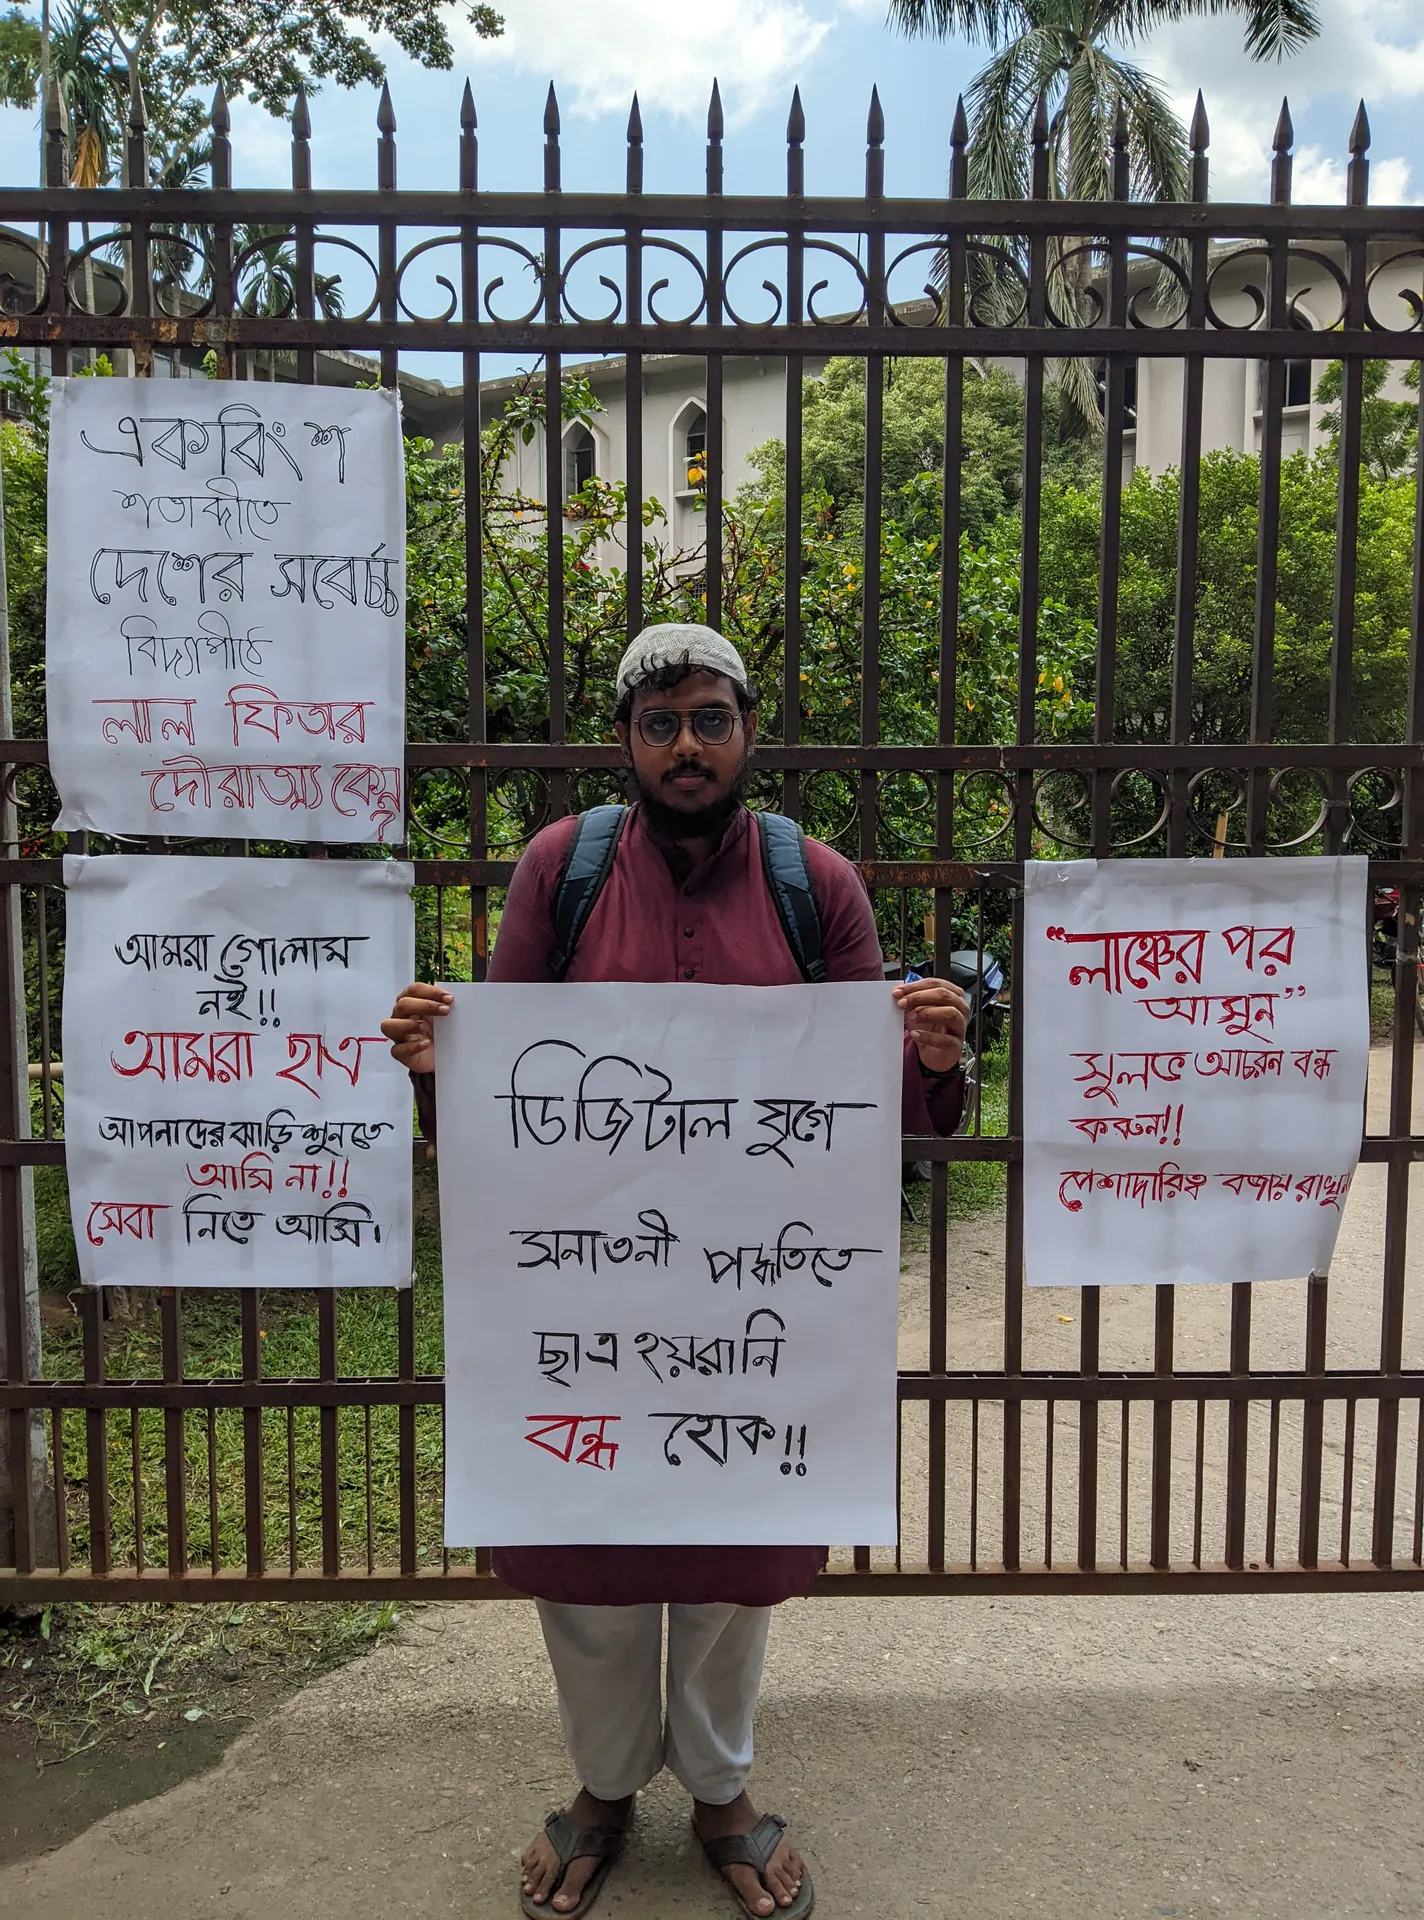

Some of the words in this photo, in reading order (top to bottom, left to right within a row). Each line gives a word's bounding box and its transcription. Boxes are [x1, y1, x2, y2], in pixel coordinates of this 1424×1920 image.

[90, 547, 254, 605] দেশের
[92, 697, 197, 746] লাল
[225, 683, 375, 747] ফিতার
[115, 934, 215, 972] আমরা
[220, 934, 370, 978] গোলাম
[1221, 925, 1295, 976] পর
[111, 1031, 260, 1083] আমরা
[1194, 1049, 1284, 1081] আচরন
[1290, 1049, 1339, 1080] বন্ধ
[494, 1039, 739, 1156] ডিজিটাল
[745, 1098, 878, 1168] যুগে
[99, 1116, 226, 1150] আপনাদের
[300, 1120, 394, 1157] শুনতে
[87, 1201, 173, 1246] সেবা
[182, 1193, 266, 1246] নিতে
[509, 1209, 680, 1275] সনাতনী
[703, 1221, 883, 1290] পদ্ধতিতে
[524, 1415, 621, 1471] বন্ধ
